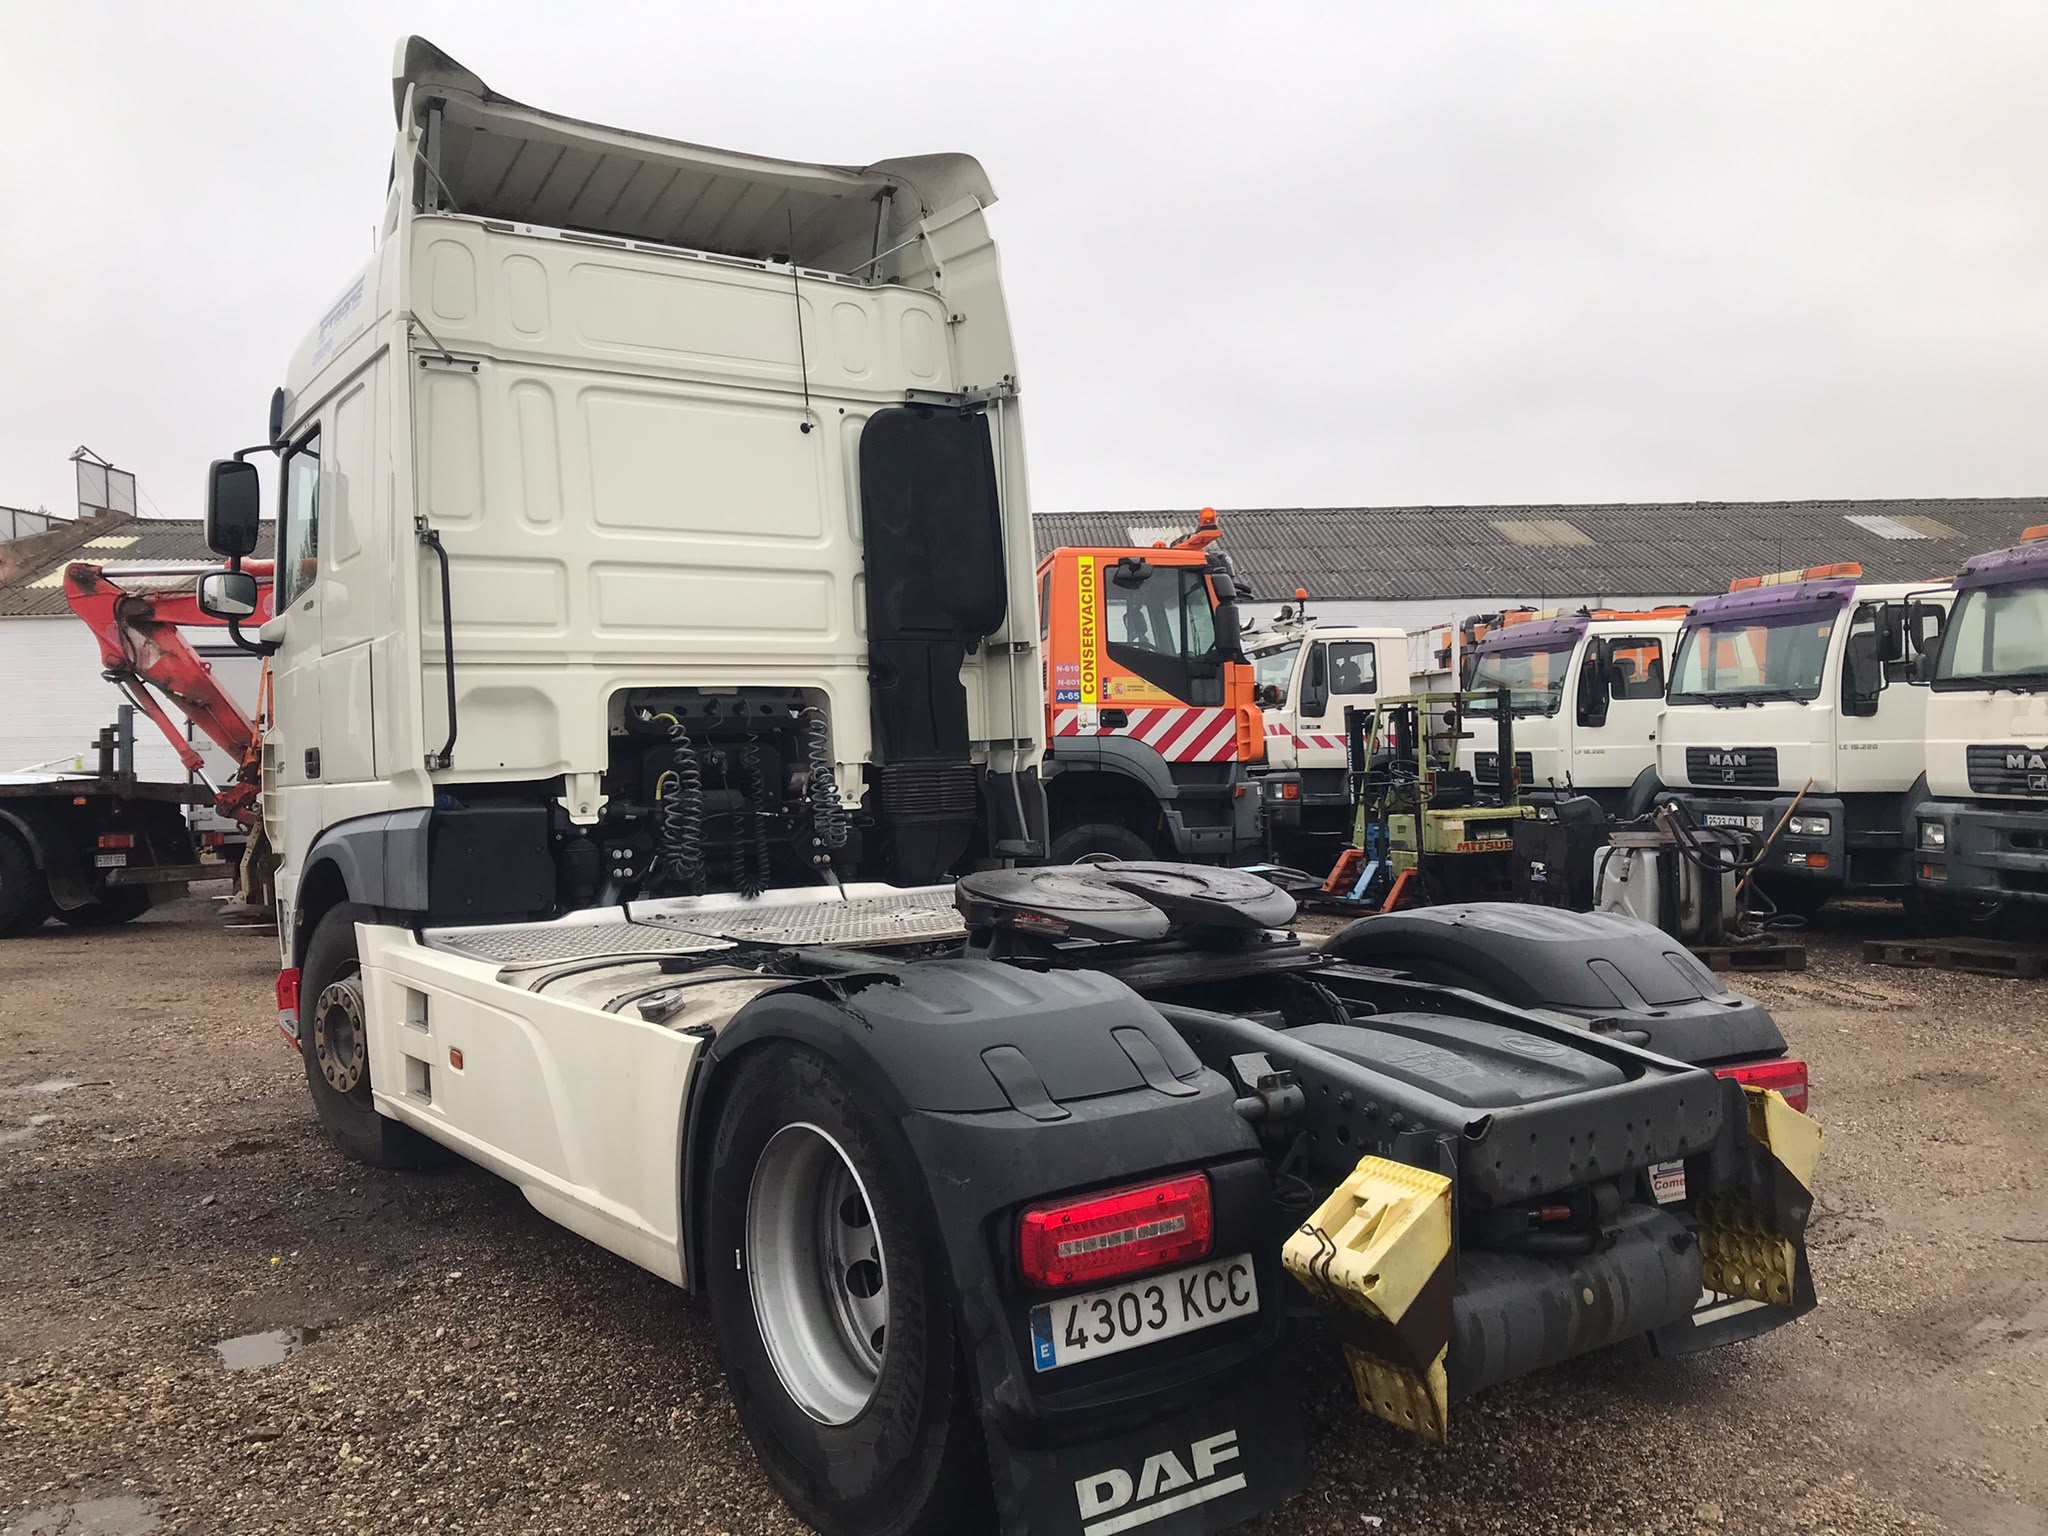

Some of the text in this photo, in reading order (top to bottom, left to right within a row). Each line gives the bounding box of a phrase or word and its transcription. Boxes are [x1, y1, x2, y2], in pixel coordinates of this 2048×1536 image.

[1081, 564, 1095, 695] CONSERVACION
[1056, 665, 1080, 673] N-610
[1057, 692, 1080, 700] A-65
[1708, 754, 1747, 767] MAN
[1065, 1264, 1250, 1349] 4303 KCC
[1040, 1344, 1050, 1358] E
[1075, 1429, 1239, 1520] DAF
